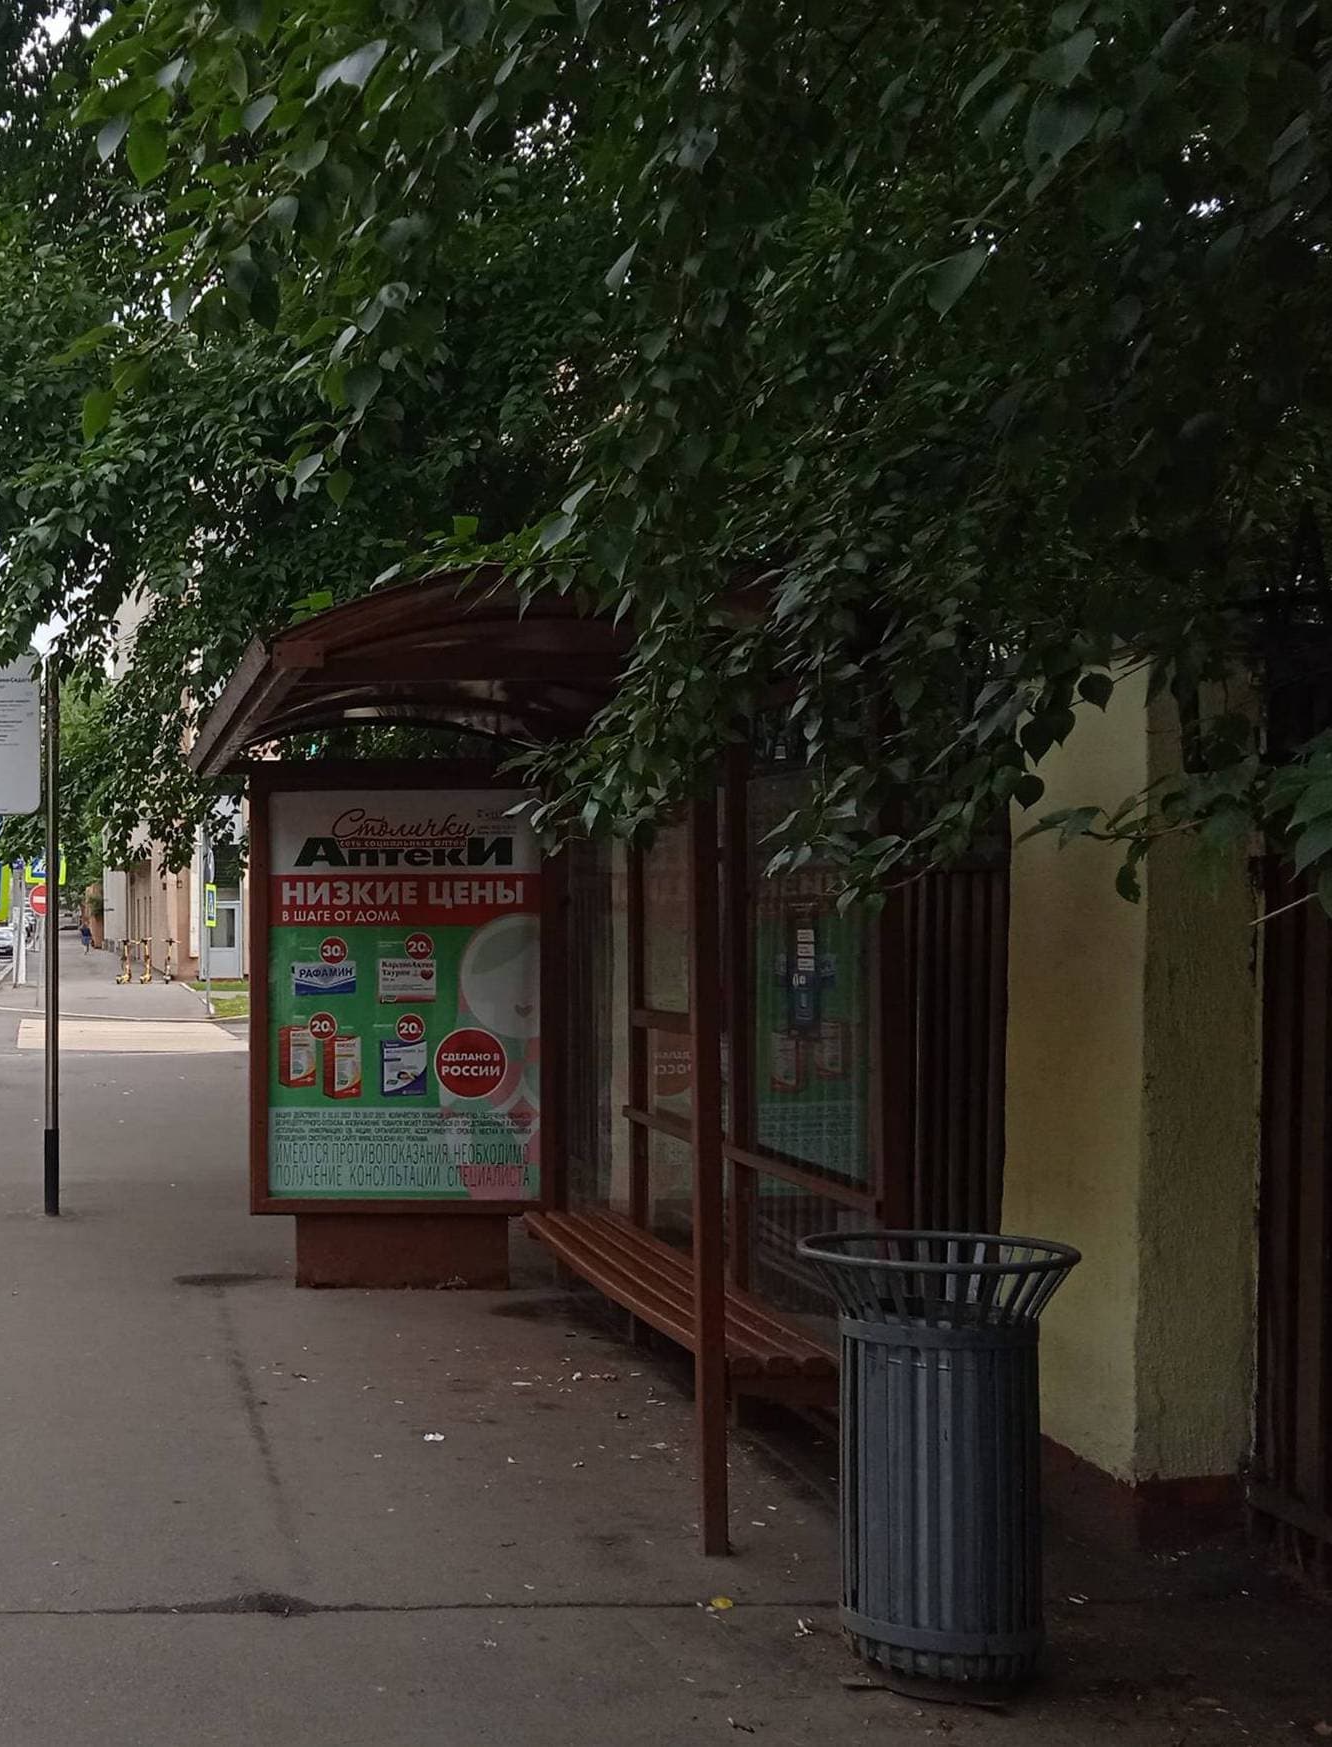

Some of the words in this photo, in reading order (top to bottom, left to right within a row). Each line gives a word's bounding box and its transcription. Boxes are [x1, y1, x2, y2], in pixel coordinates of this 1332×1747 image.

[332, 808, 476, 838] Столички
[281, 881, 418, 905] НИЗКИЕ
[428, 880, 524, 909] ЦЕНЫ
[281, 911, 290, 922] В
[294, 911, 331, 922] ШАГЕ
[334, 911, 352, 922] ОТ
[355, 911, 401, 923] ДОМА
[299, 966, 353, 979] РАФАМИН
[441, 1053, 491, 1062] СДЕЛАНО
[441, 1066, 500, 1077] РОССИИ
[275, 1143, 329, 1165] ИМЕЮТСЯ
[453, 1143, 530, 1165] НЕОБХОДИМО
[275, 1165, 342, 1187] ПОЛУЧЕНИЕ
[349, 1165, 441, 1188] КОНСУЛЬТАЦИИ
[447, 1165, 530, 1188] СПЕЦИАЛИСТА
